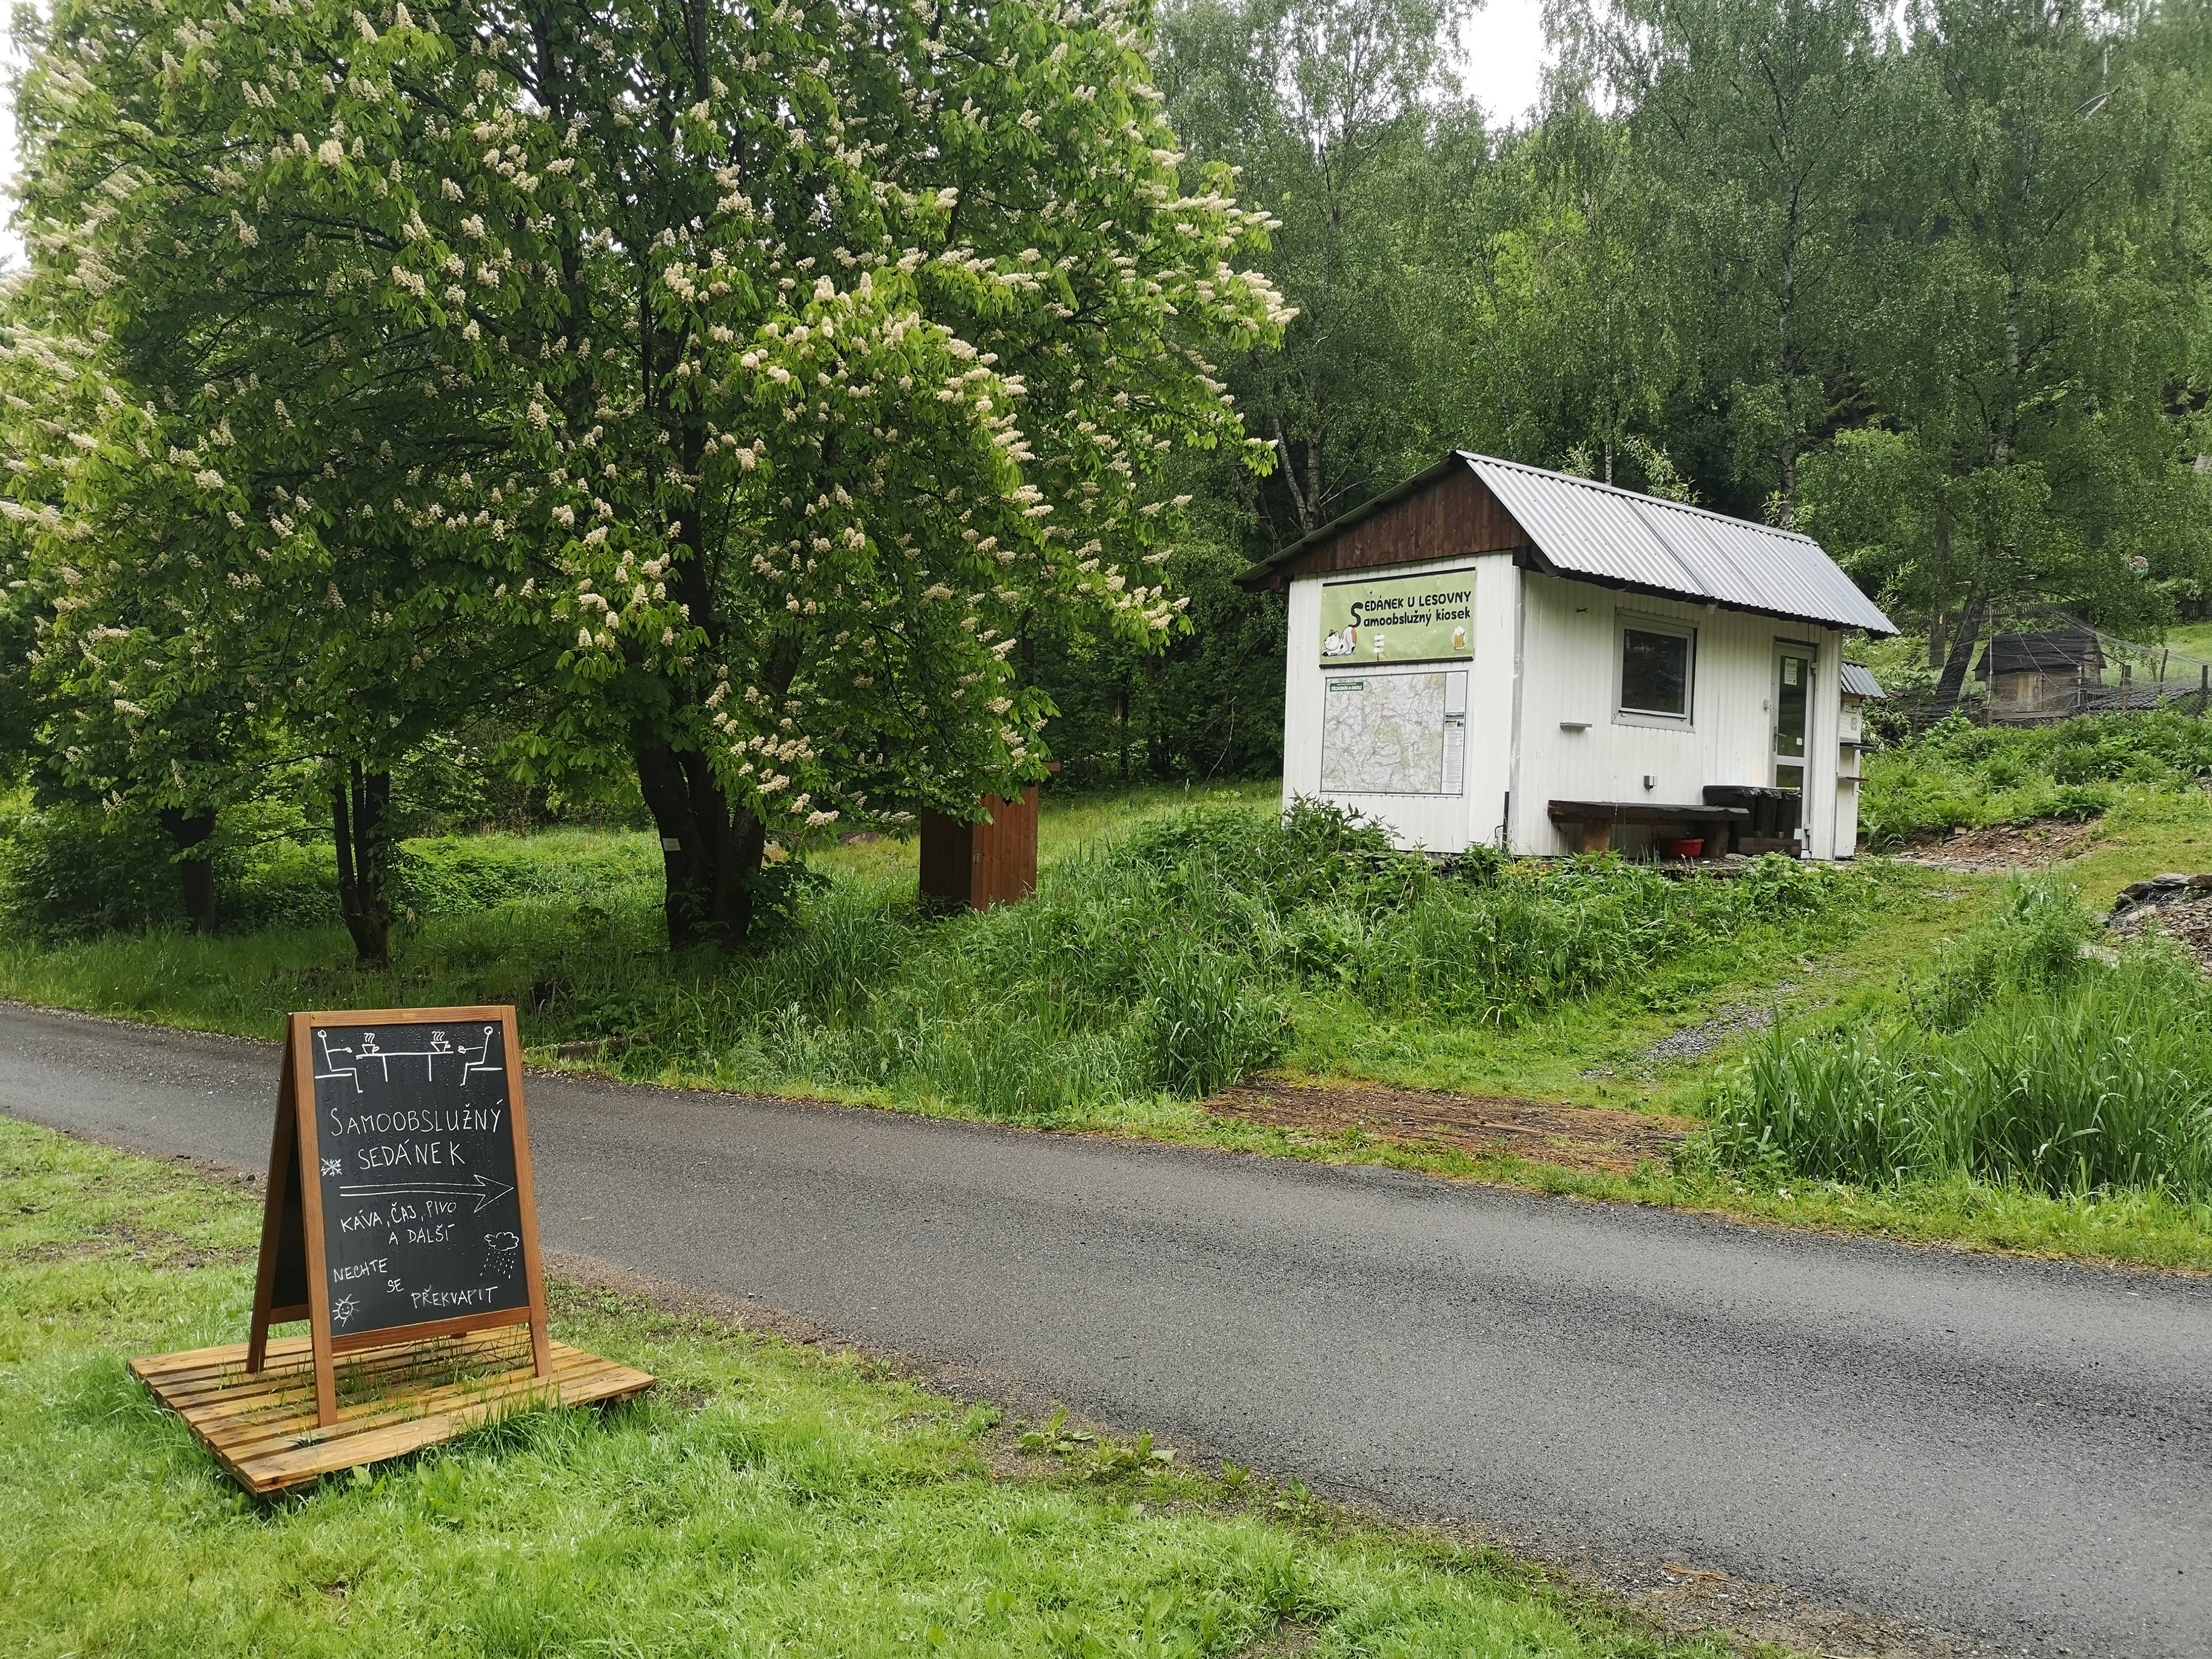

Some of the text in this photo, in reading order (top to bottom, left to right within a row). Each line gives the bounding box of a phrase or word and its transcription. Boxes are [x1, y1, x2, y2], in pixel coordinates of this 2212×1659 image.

[1407, 597, 1415, 608] U
[1419, 591, 1472, 607] LESOVNY
[1436, 606, 1470, 622] kiosek
[330, 1099, 503, 1136] SAMOOBSLUŽNÝ
[358, 1139, 465, 1170] SEDÁNEK
[426, 1200, 457, 1218] PIVO
[389, 1223, 455, 1245] A DALŠÍ
[333, 1258, 388, 1282] NECHTE
[386, 1278, 498, 1309] SE PŘEKVAPIT
